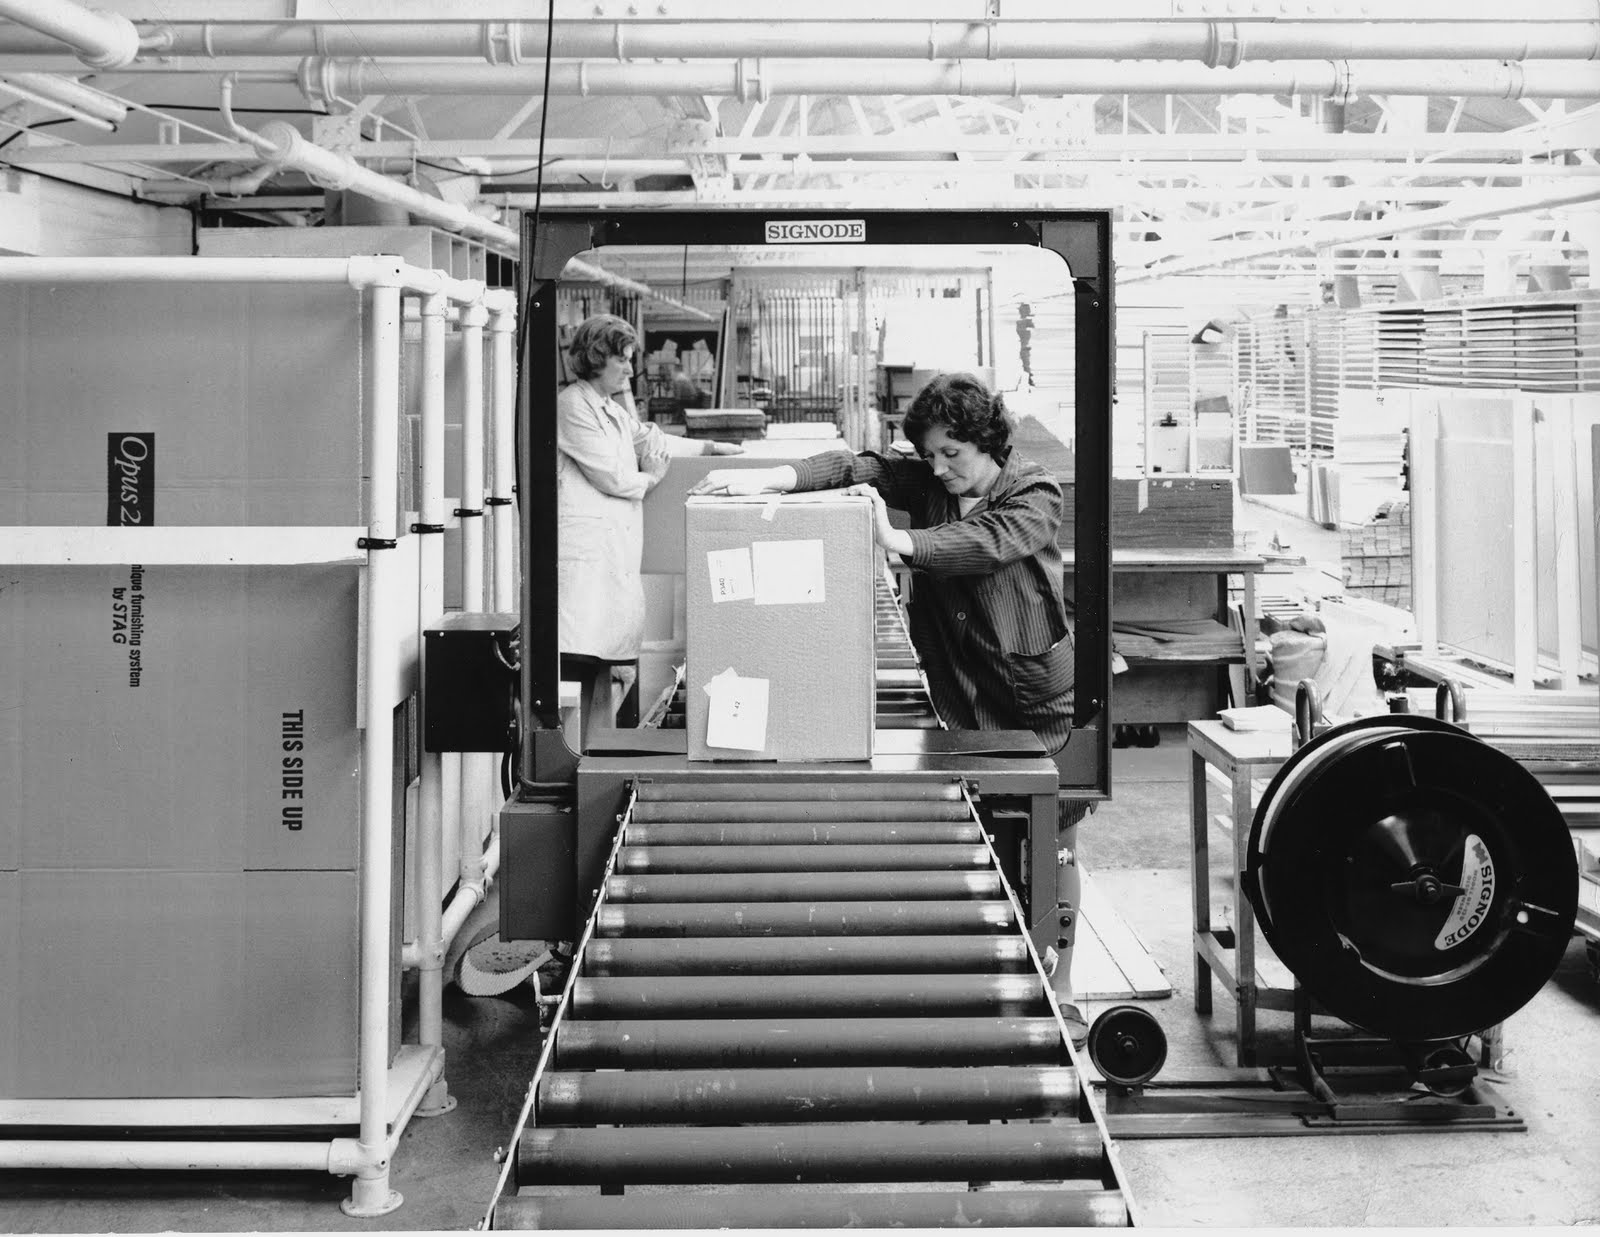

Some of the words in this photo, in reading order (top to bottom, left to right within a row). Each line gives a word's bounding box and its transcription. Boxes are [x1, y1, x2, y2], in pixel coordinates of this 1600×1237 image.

[768, 224, 862, 239] SIGNODE
[114, 436, 148, 504] Opus
[120, 505, 141, 526] 2
[112, 587, 127, 600] by
[129, 564, 145, 591] nique
[112, 603, 127, 644] STAG
[129, 594, 144, 646] furnishing
[129, 649, 143, 687] system
[282, 709, 303, 751] THIS
[282, 757, 303, 799] SIDE
[282, 807, 303, 831] UP
[1444, 865, 1492, 946] SIGNODE
